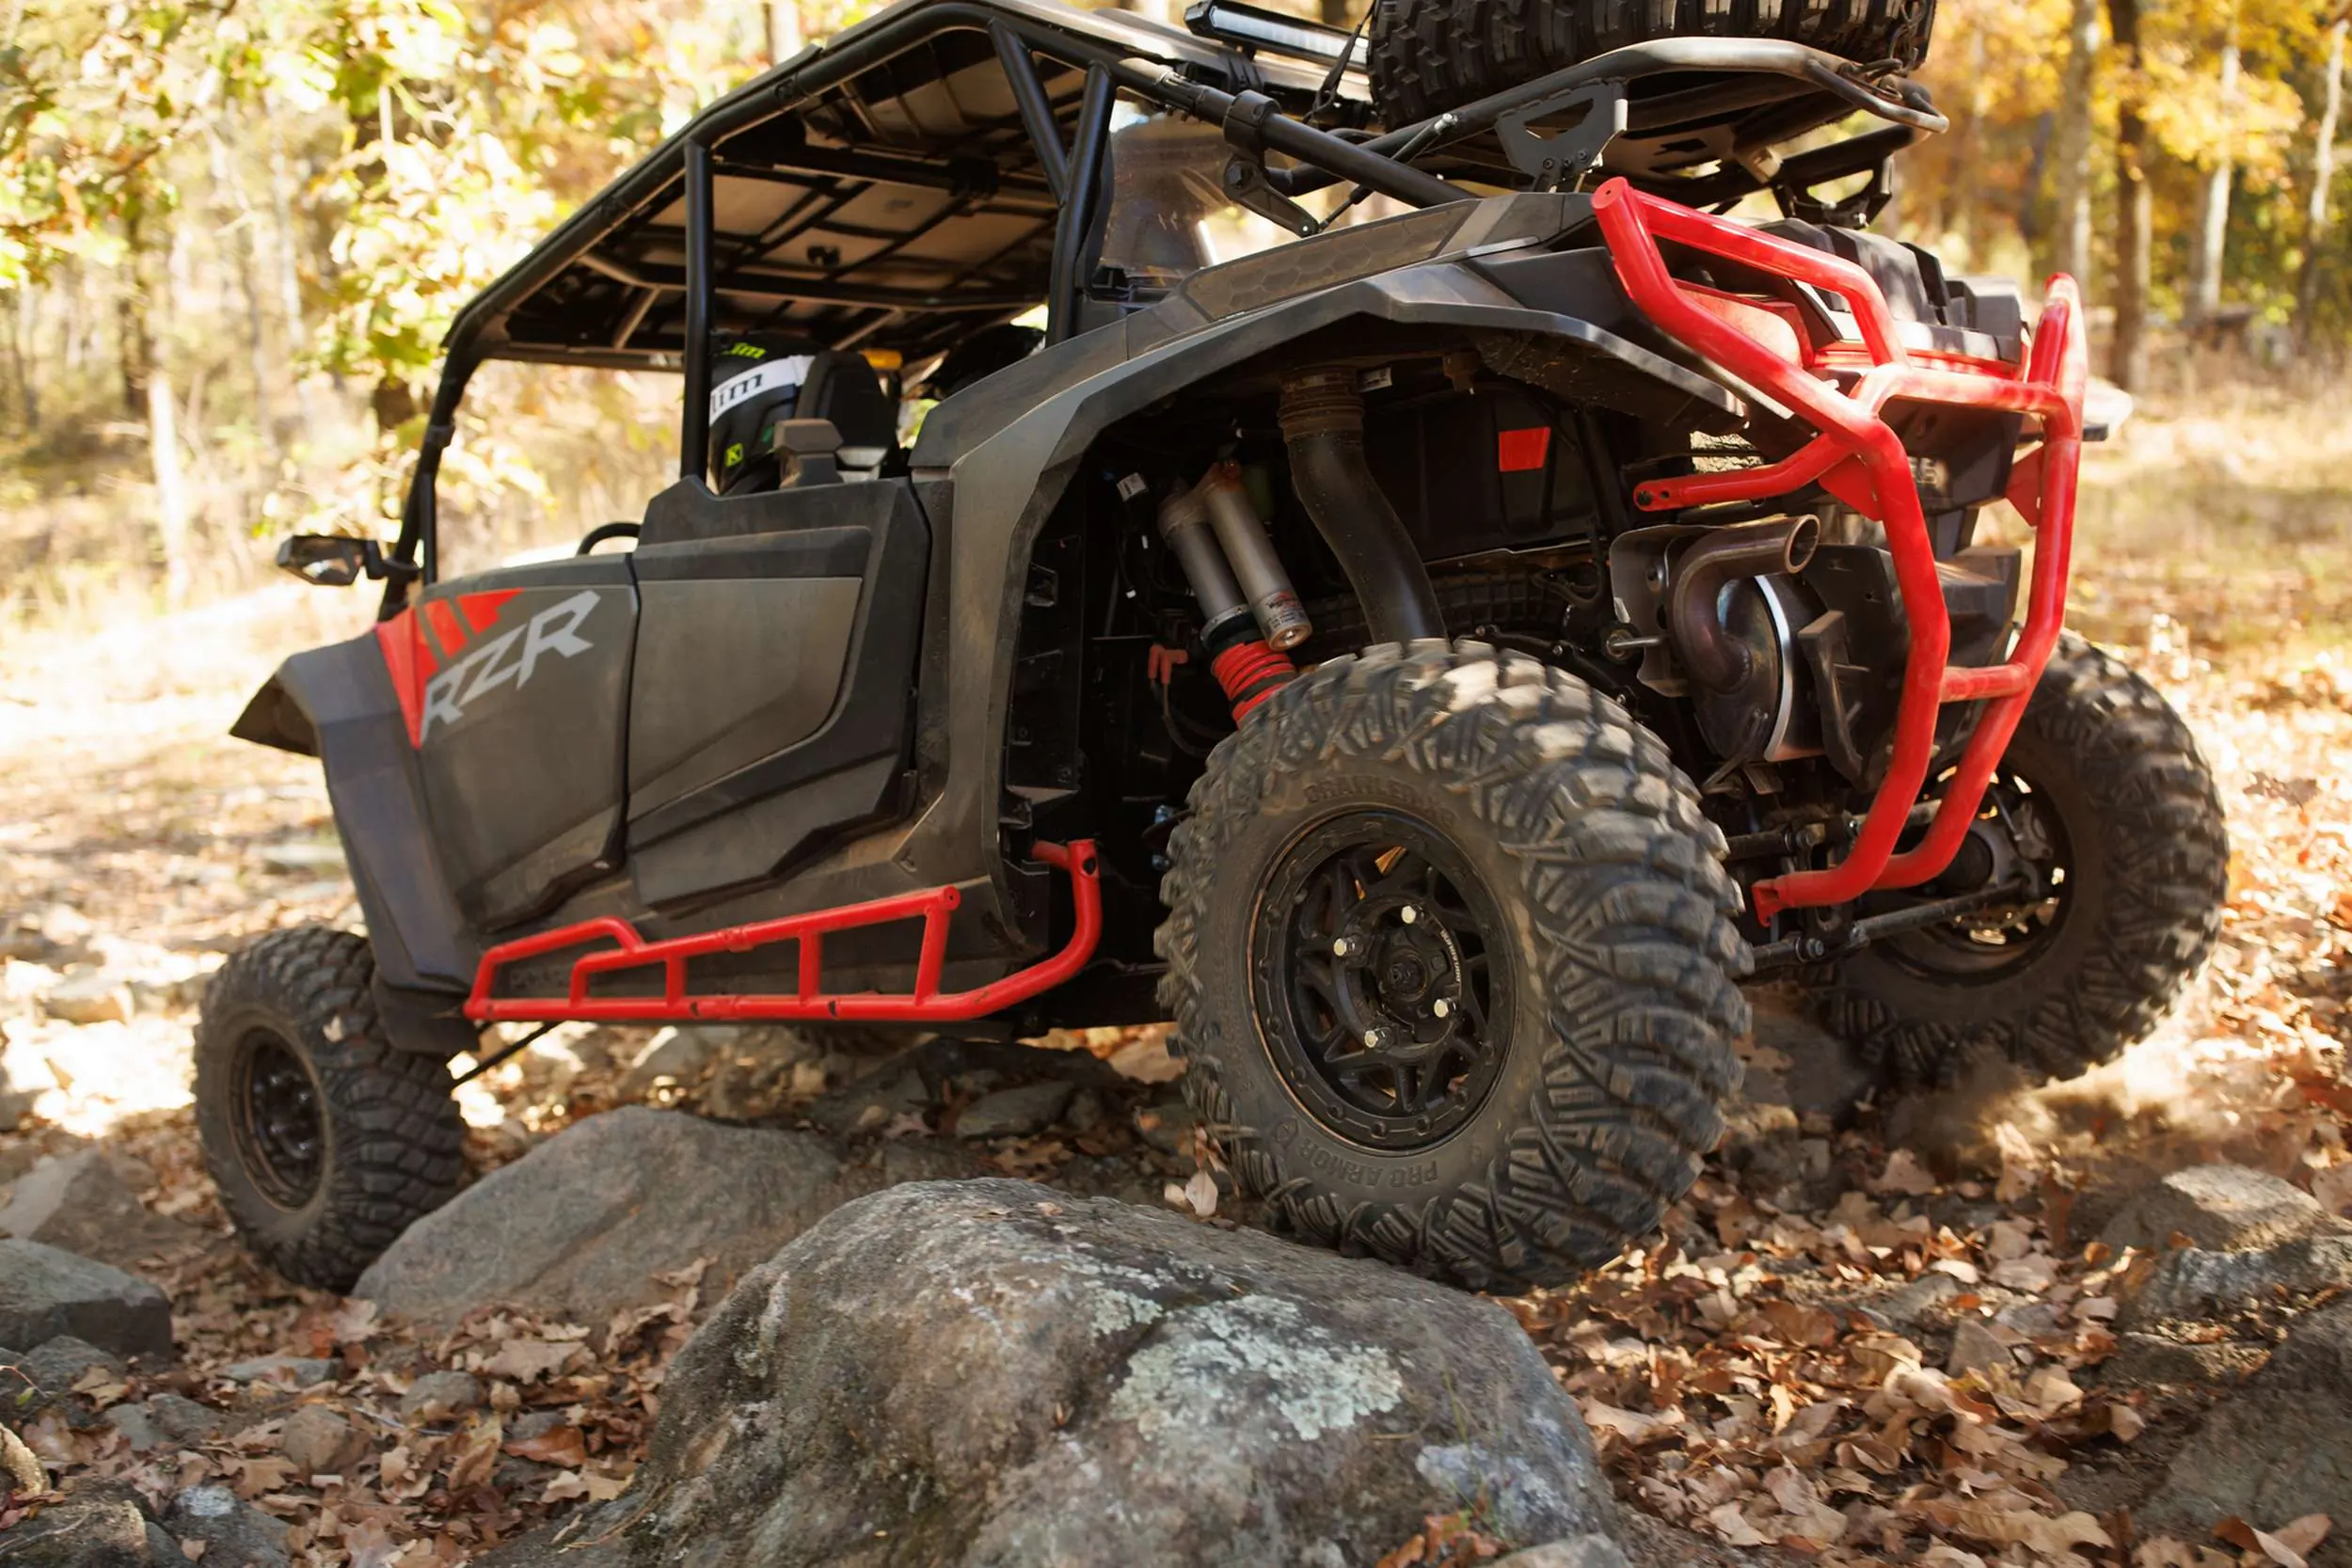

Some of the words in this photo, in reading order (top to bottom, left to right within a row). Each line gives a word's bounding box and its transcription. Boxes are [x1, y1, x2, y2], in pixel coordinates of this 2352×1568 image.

[712, 372, 763, 414] lim
[420, 590, 601, 746] RZR
[1297, 1138, 1383, 1187] ARMOR
[1389, 1161, 1438, 1188] PRO
